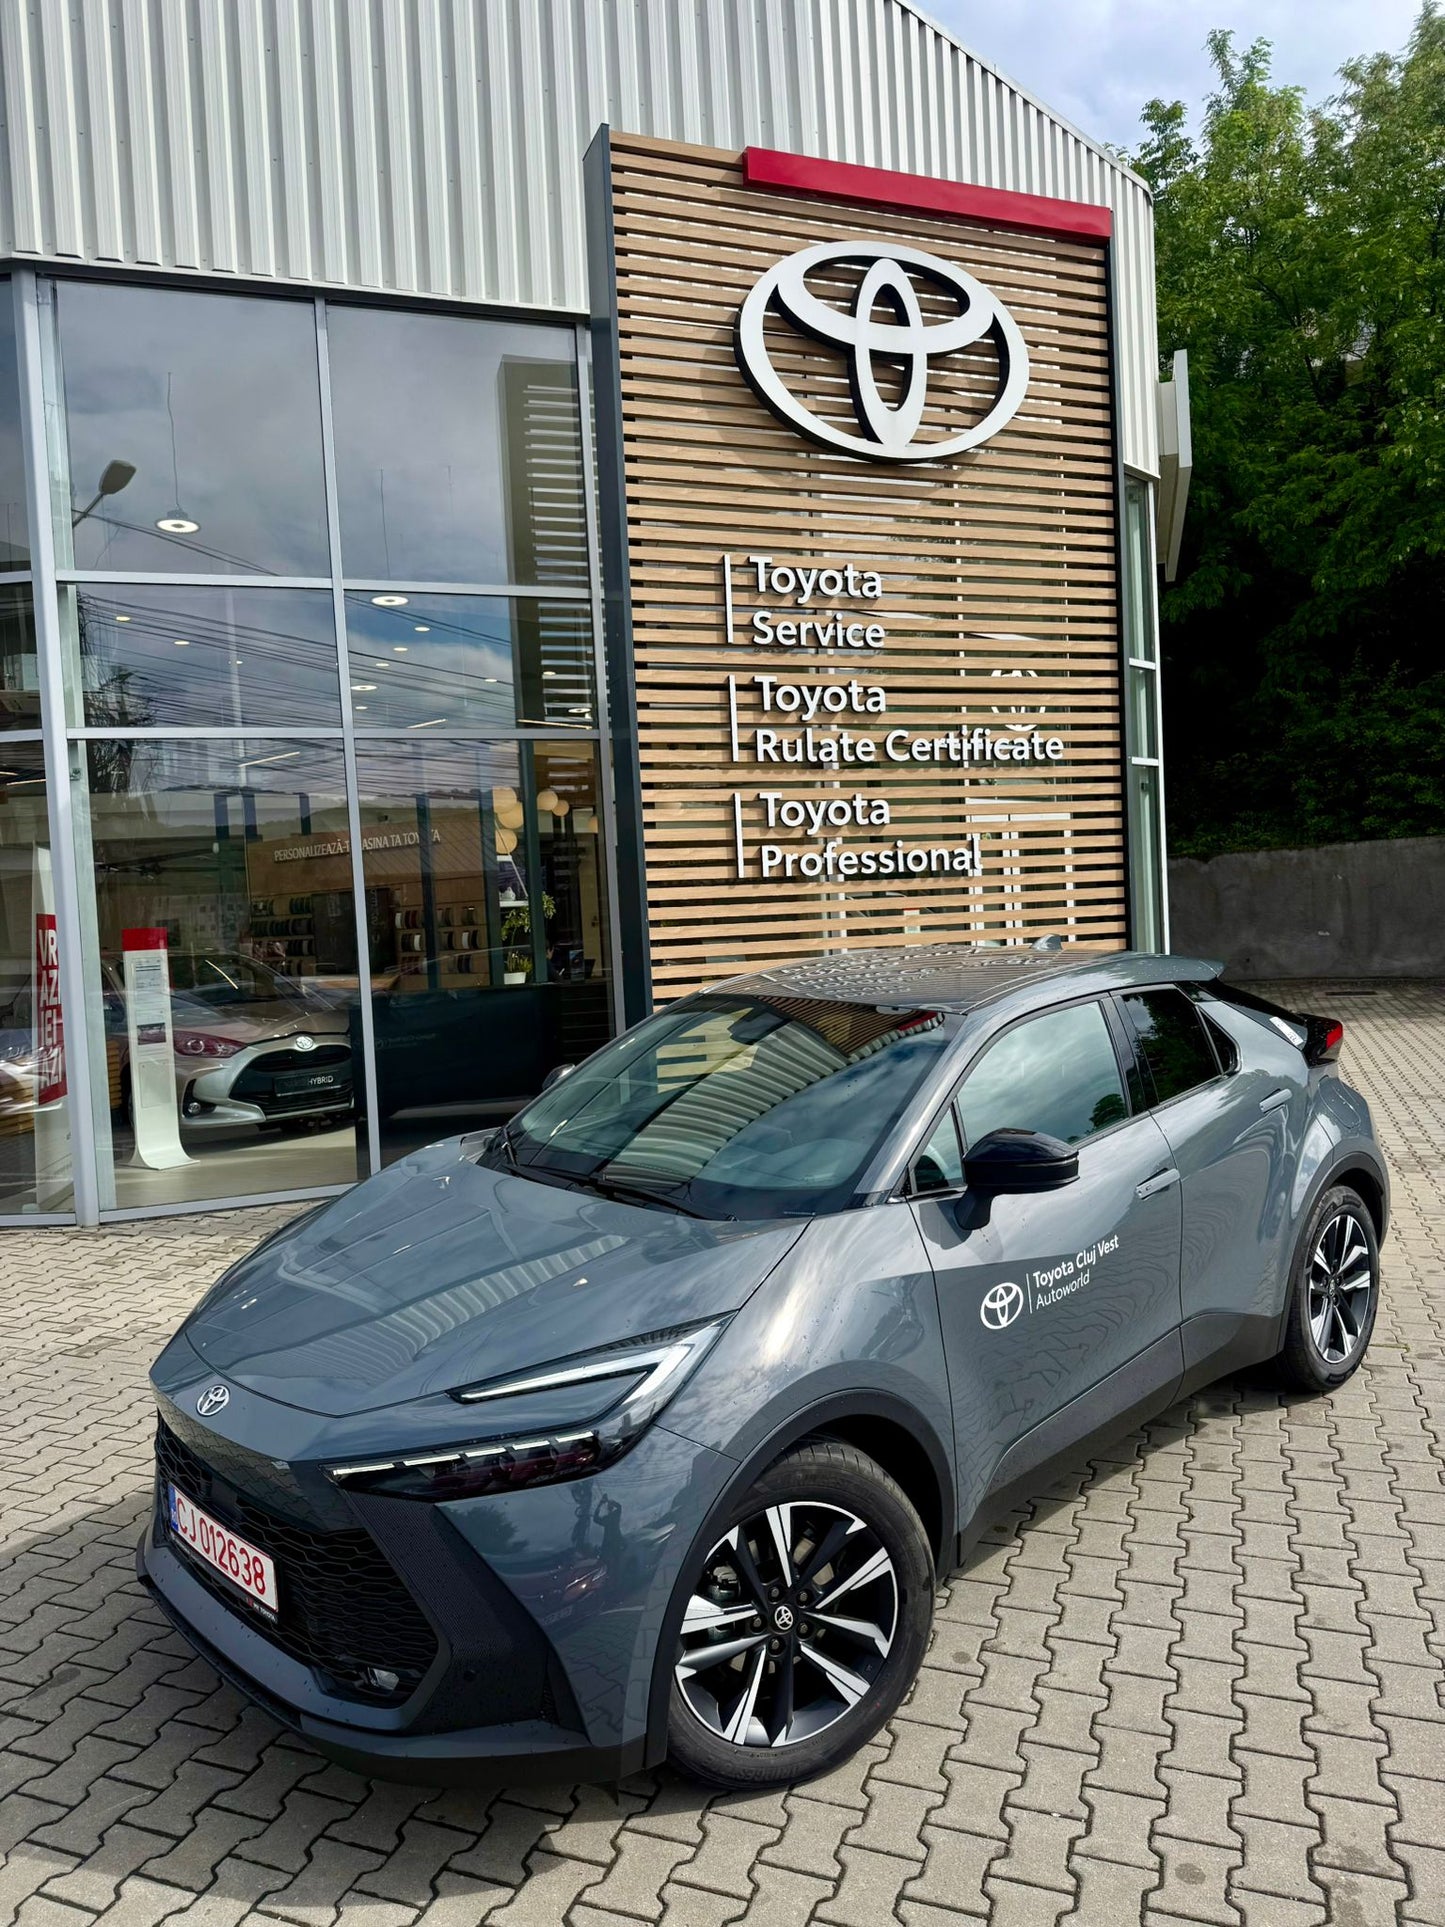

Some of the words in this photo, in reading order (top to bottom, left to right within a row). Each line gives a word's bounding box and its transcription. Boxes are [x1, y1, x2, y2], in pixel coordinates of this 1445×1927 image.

[749, 555, 882, 604] Toyota
[753, 611, 885, 648] Service
[753, 675, 886, 721] Toyota
[756, 728, 877, 762] Rulate
[886, 728, 1064, 761] Certificate
[759, 792, 890, 835] Toyota
[390, 834, 401, 846] TA
[403, 829, 440, 845] TOYA
[761, 834, 983, 877] Professional
[308, 1075, 334, 1086] HYBRID
[1033, 1260, 1074, 1288] Toyota
[1076, 1245, 1096, 1268] Cluj
[1097, 1234, 1120, 1257] Vest
[1036, 1269, 1090, 1310] Autoworld
